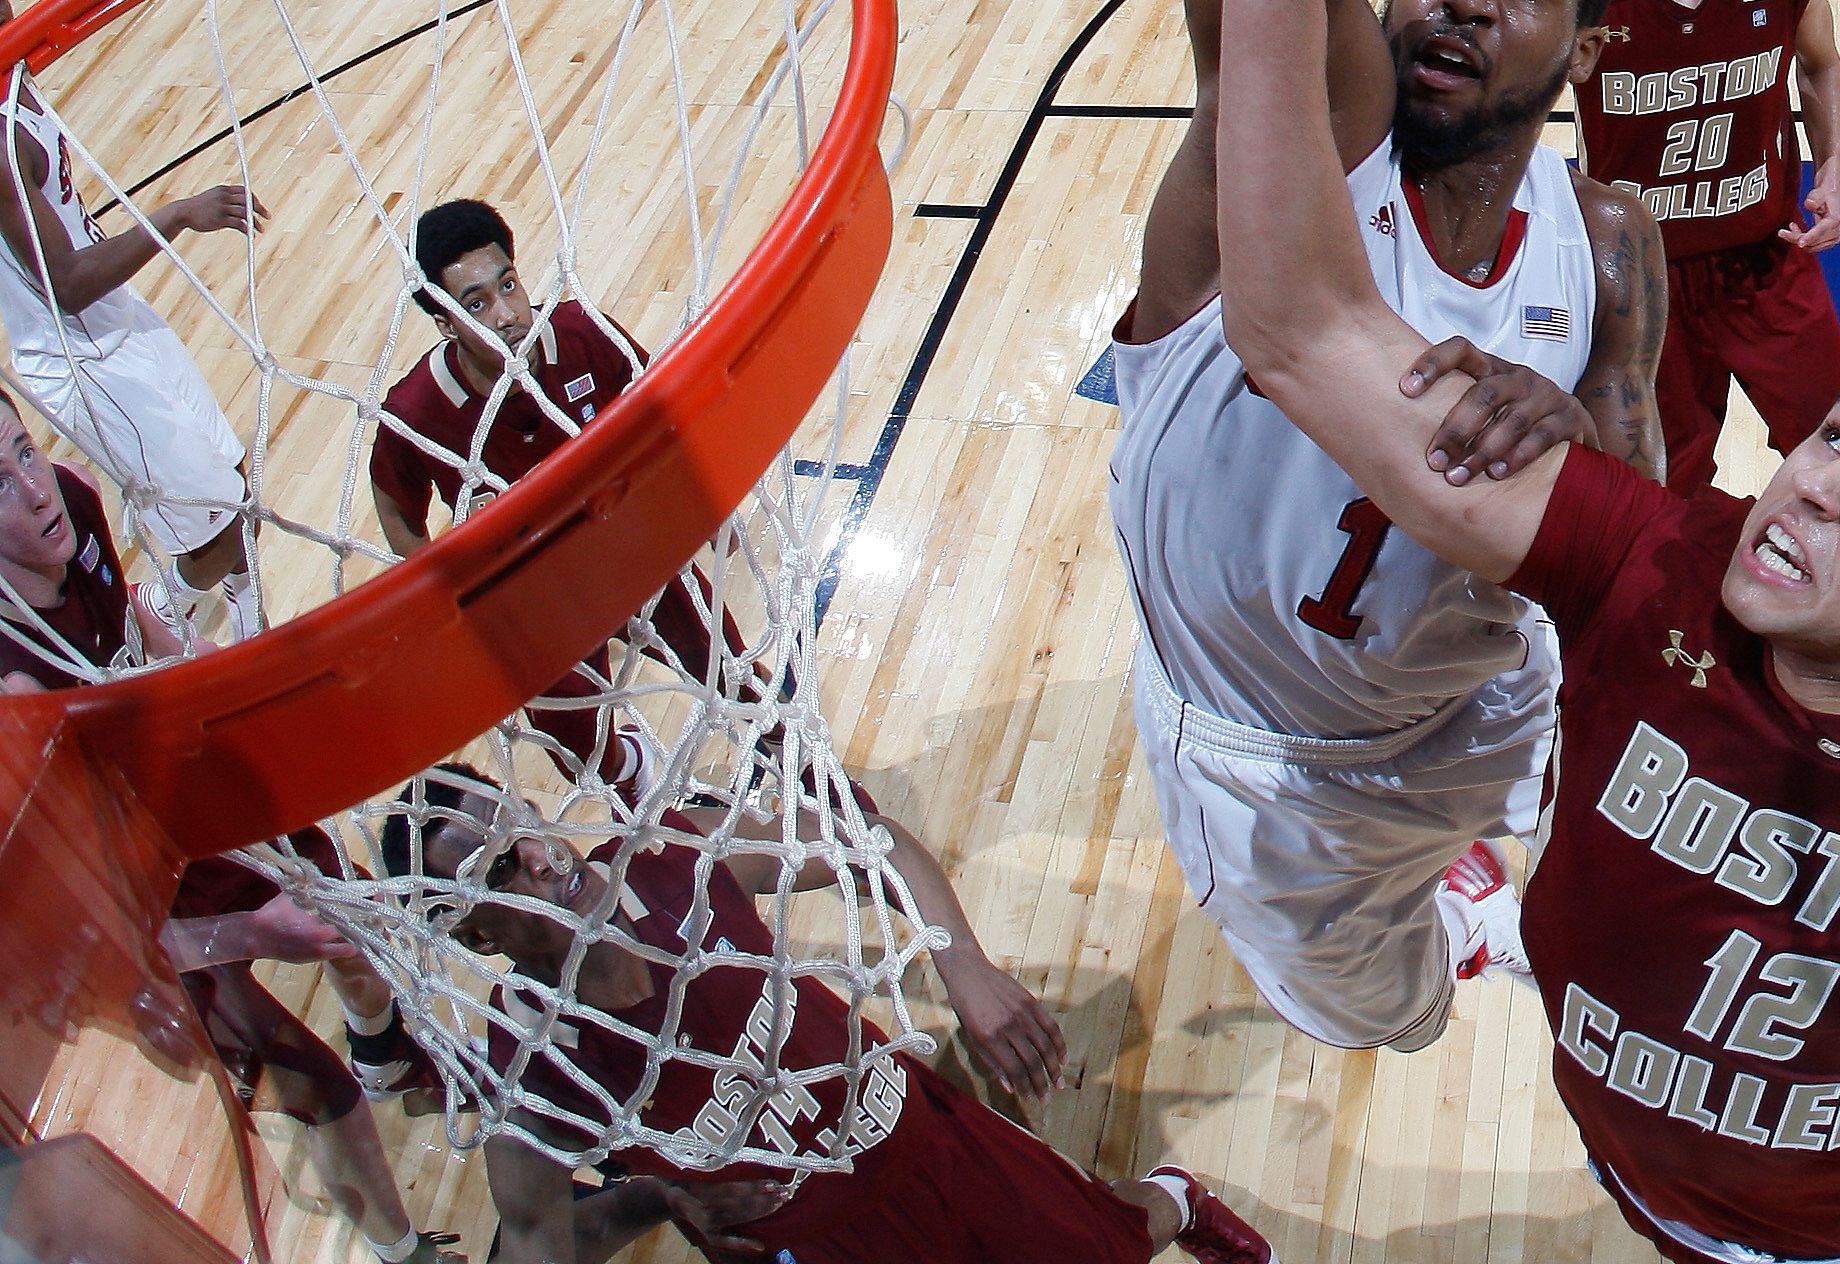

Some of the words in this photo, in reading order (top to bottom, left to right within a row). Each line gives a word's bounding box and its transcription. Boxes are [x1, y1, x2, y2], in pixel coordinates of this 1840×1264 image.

[1601, 46, 1784, 116] BOSTON
[1659, 113, 1735, 178] 20
[1610, 164, 1769, 223] OLLEG
[1296, 495, 1395, 641] 1
